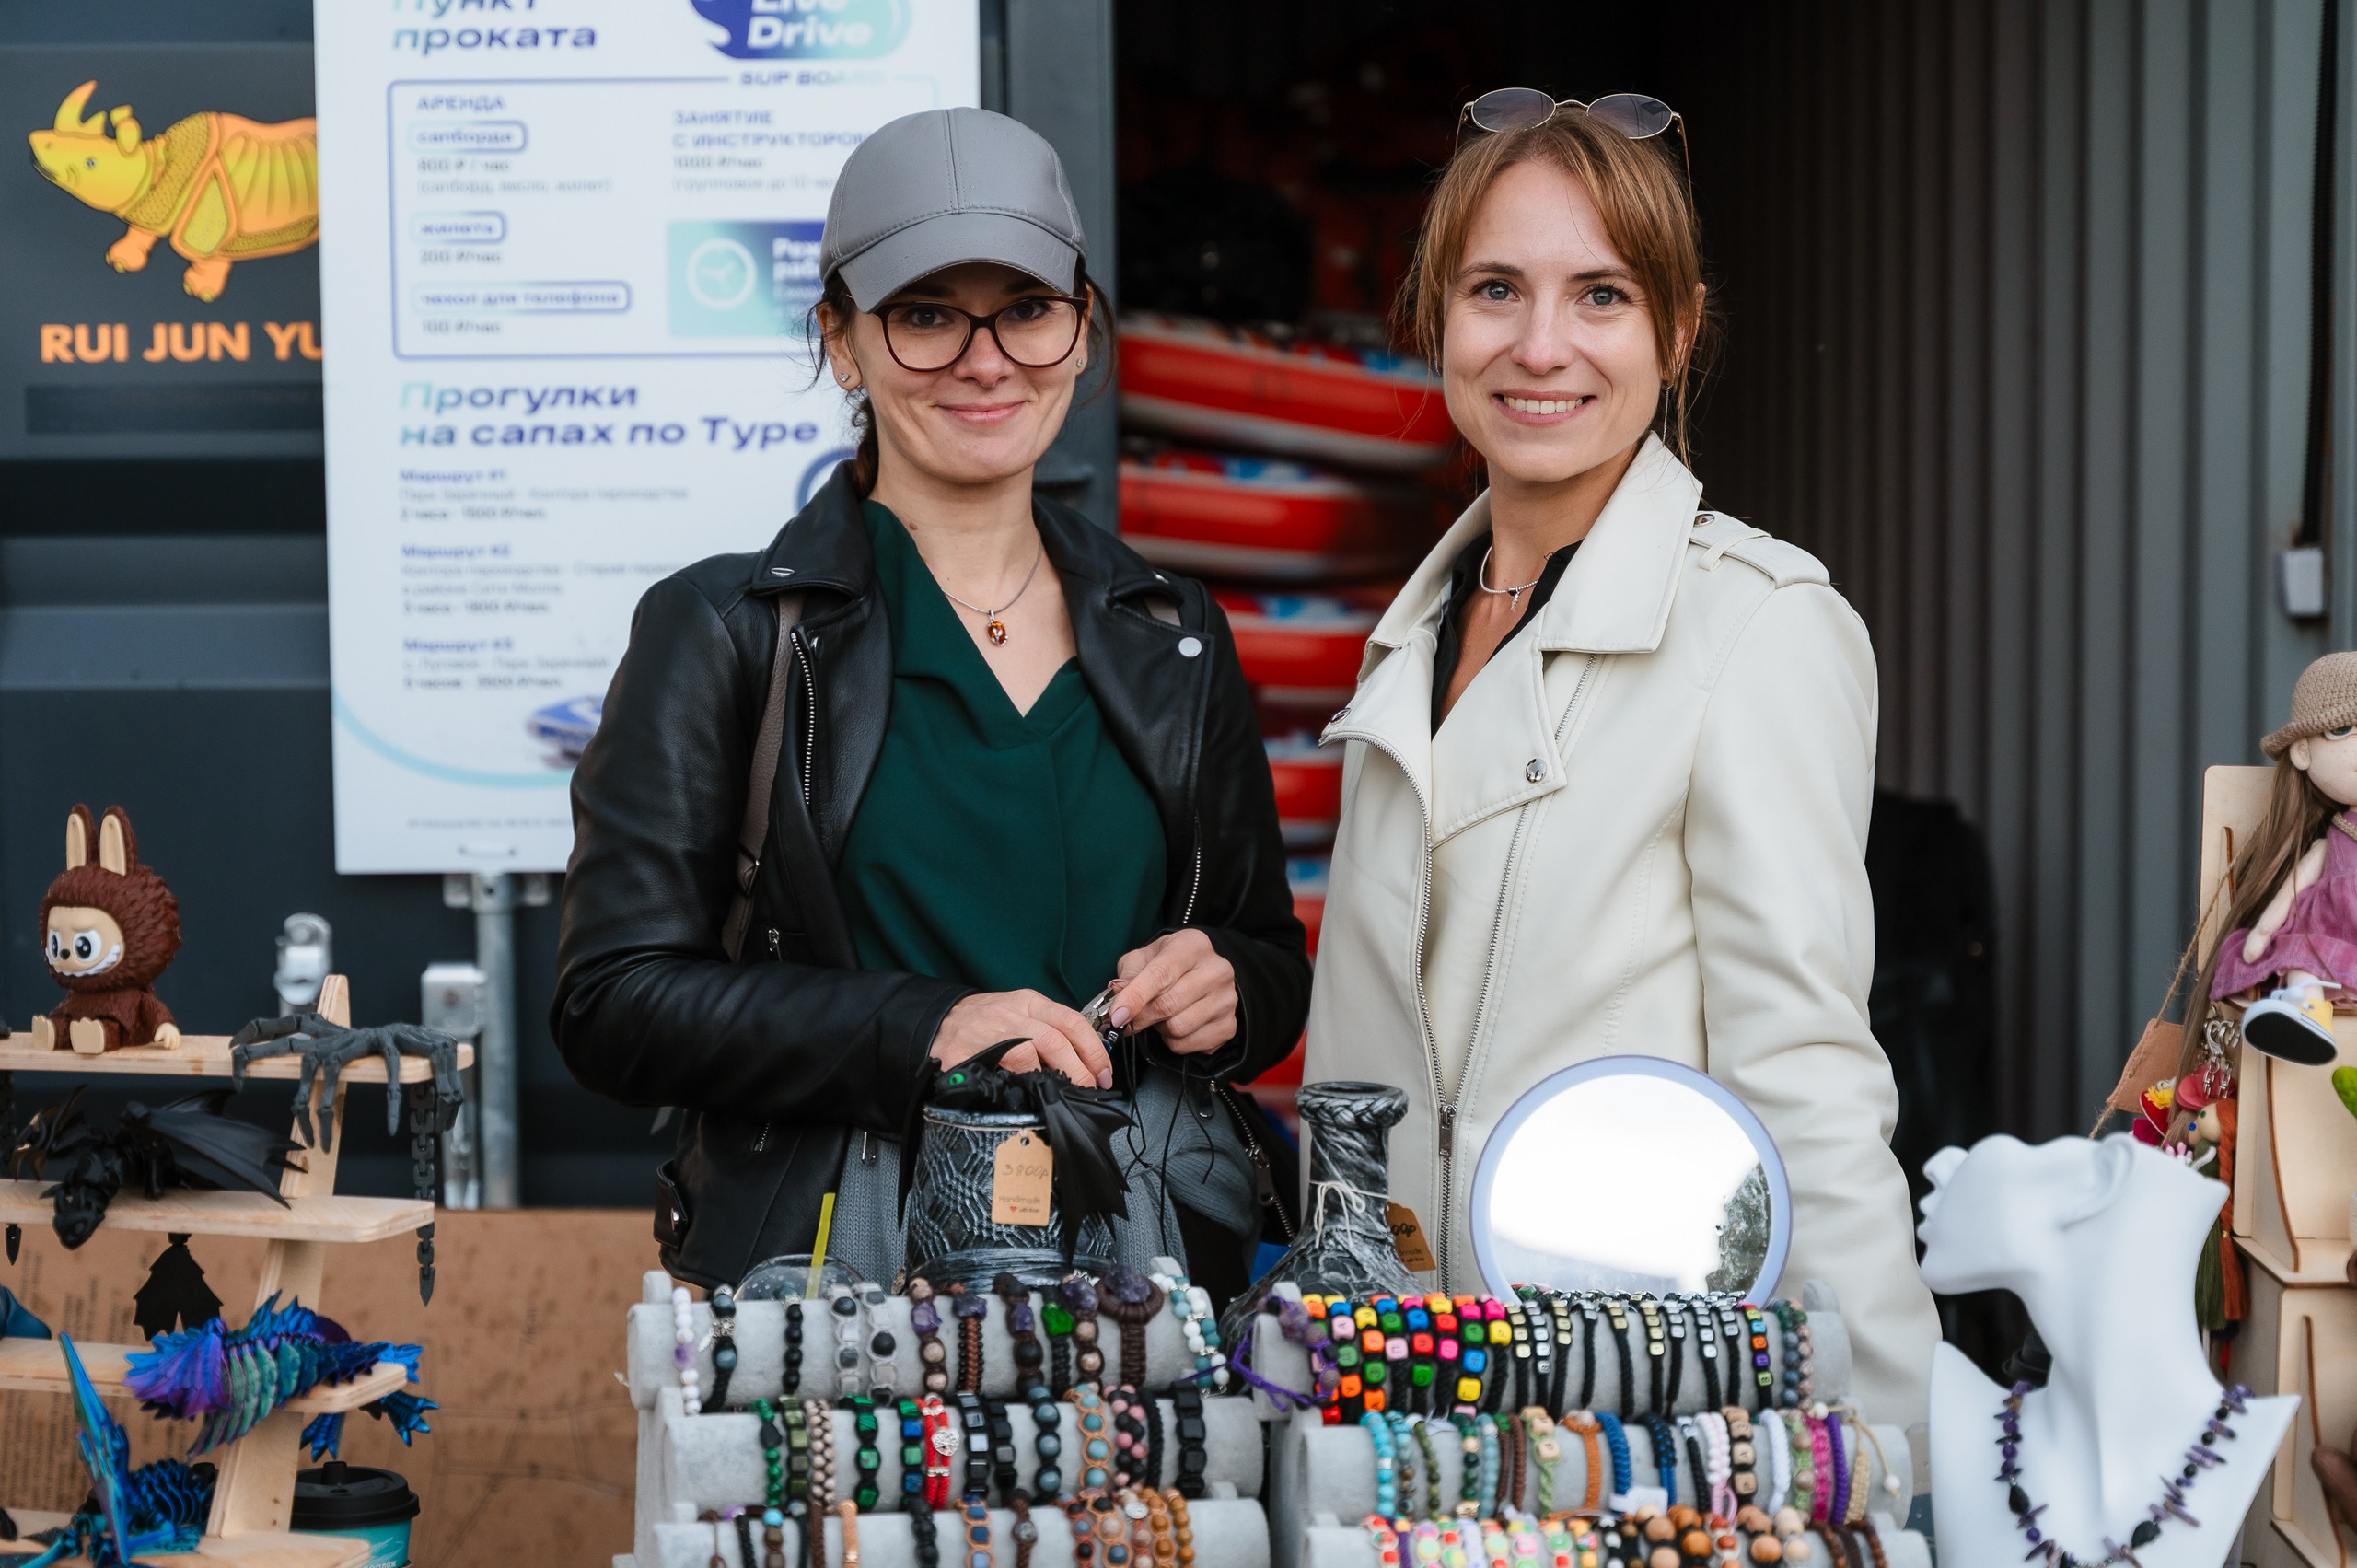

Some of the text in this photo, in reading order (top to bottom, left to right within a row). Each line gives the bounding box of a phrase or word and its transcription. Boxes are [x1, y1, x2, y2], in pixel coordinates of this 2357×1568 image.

[747, 17, 871, 48] Drive
[393, 29, 597, 55] проката
[742, 71, 790, 85] SUP
[417, 96, 505, 111] АРЕНДА
[673, 111, 772, 125] ЗАНЯТИЕ
[417, 129, 512, 144] сапборда
[421, 223, 493, 236] жилета
[421, 290, 619, 310] чехол для телефона
[41, 323, 129, 363] RUI
[143, 322, 250, 361] JUN
[401, 382, 637, 414] Прогулки
[401, 417, 819, 451] на сапах по Туре
[399, 469, 482, 483] Маршрут
[401, 543, 485, 559] Маршрут
[402, 637, 486, 652] Маршрут
